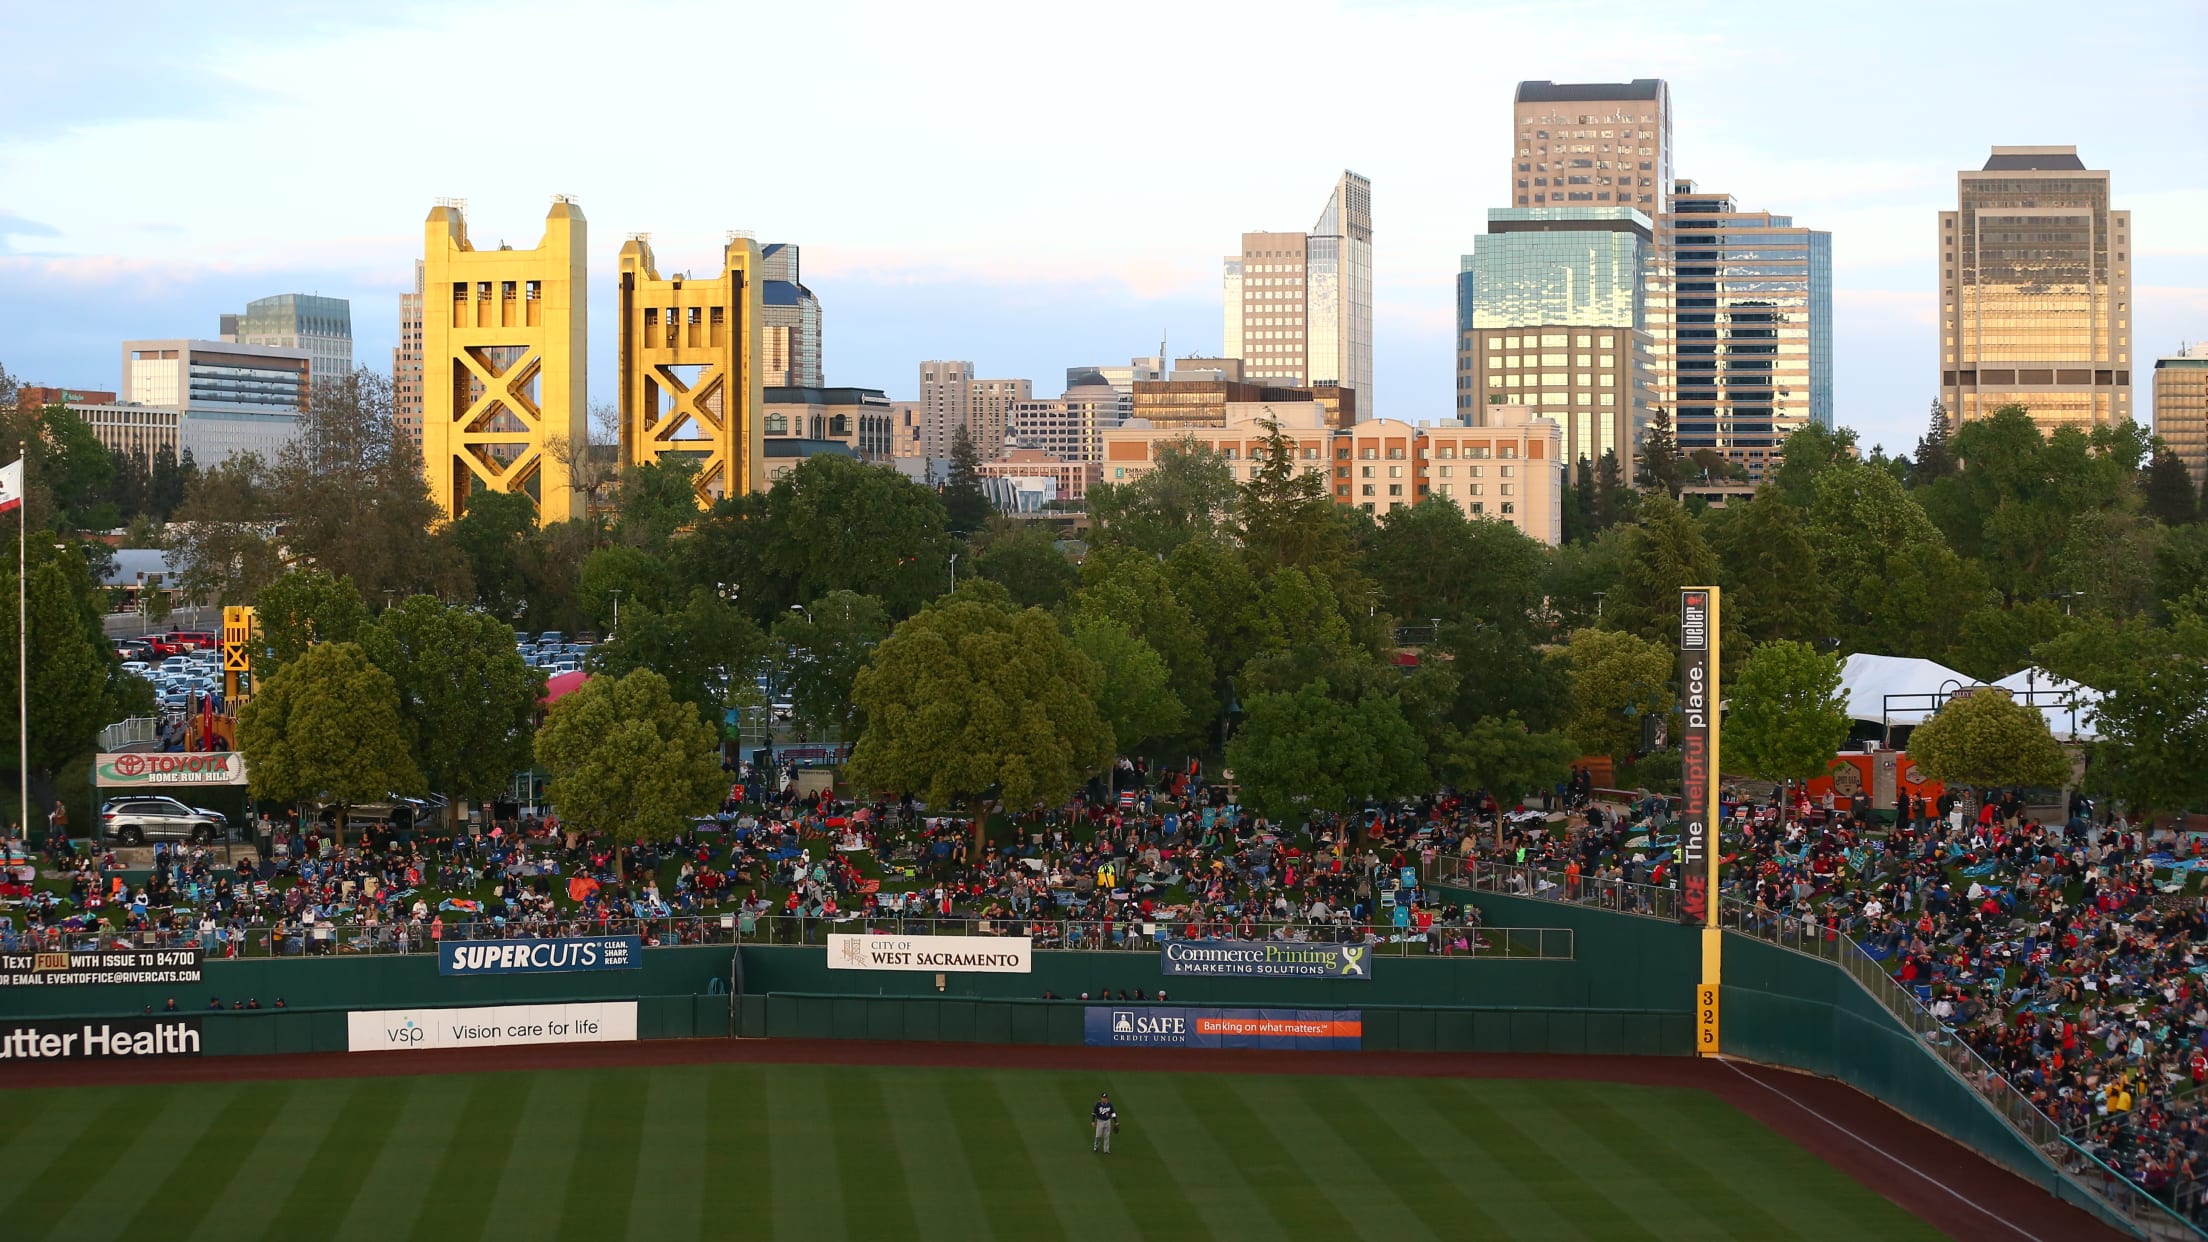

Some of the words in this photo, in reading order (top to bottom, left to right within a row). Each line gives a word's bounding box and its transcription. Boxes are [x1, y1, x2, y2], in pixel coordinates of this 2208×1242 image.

[1683, 607, 1704, 646] weber
[1685, 661, 1706, 728] place.
[147, 756, 229, 772] TOYOTA
[148, 773, 178, 782] HOME
[180, 773, 202, 782] RUN
[206, 772, 229, 781] HILL
[1685, 736, 1707, 814] helpful
[1685, 821, 1703, 864] The
[1682, 875, 1706, 920] ACE
[604, 941, 628, 949] CLEAN.
[605, 949, 628, 957] SHARP.
[871, 941, 895, 950] CITY
[898, 942, 911, 950] OF
[38, 955, 67, 968] FOUL
[71, 955, 99, 968] WITH
[102, 954, 135, 967] ISSUE
[139, 953, 153, 967] TO
[157, 952, 195, 966] 84700
[605, 957, 628, 965] READY.
[871, 952, 912, 964] WEST
[917, 953, 1019, 967] SACRAMENTO
[1167, 943, 1263, 963] Commerce
[1265, 945, 1337, 969] Printing
[1184, 963, 1253, 973] MARKETING
[1257, 965, 1324, 974] SOLUTIONS
[13, 974, 43, 985] EMAIL
[47, 971, 200, 984] EVENTOFFICE@RIVERCATS.COM
[453, 1025, 501, 1039] Vision
[507, 1024, 542, 1037] care
[549, 1020, 569, 1035] for
[575, 1019, 598, 1034] life
[1137, 1017, 1186, 1034] SAFE
[1204, 1021, 1243, 1034] Banking
[1244, 1024, 1257, 1032] on
[1259, 1022, 1283, 1032] what
[83, 1023, 200, 1056] Health
[388, 1027, 423, 1046] vsp
[1154, 1035, 1185, 1043] UNION
